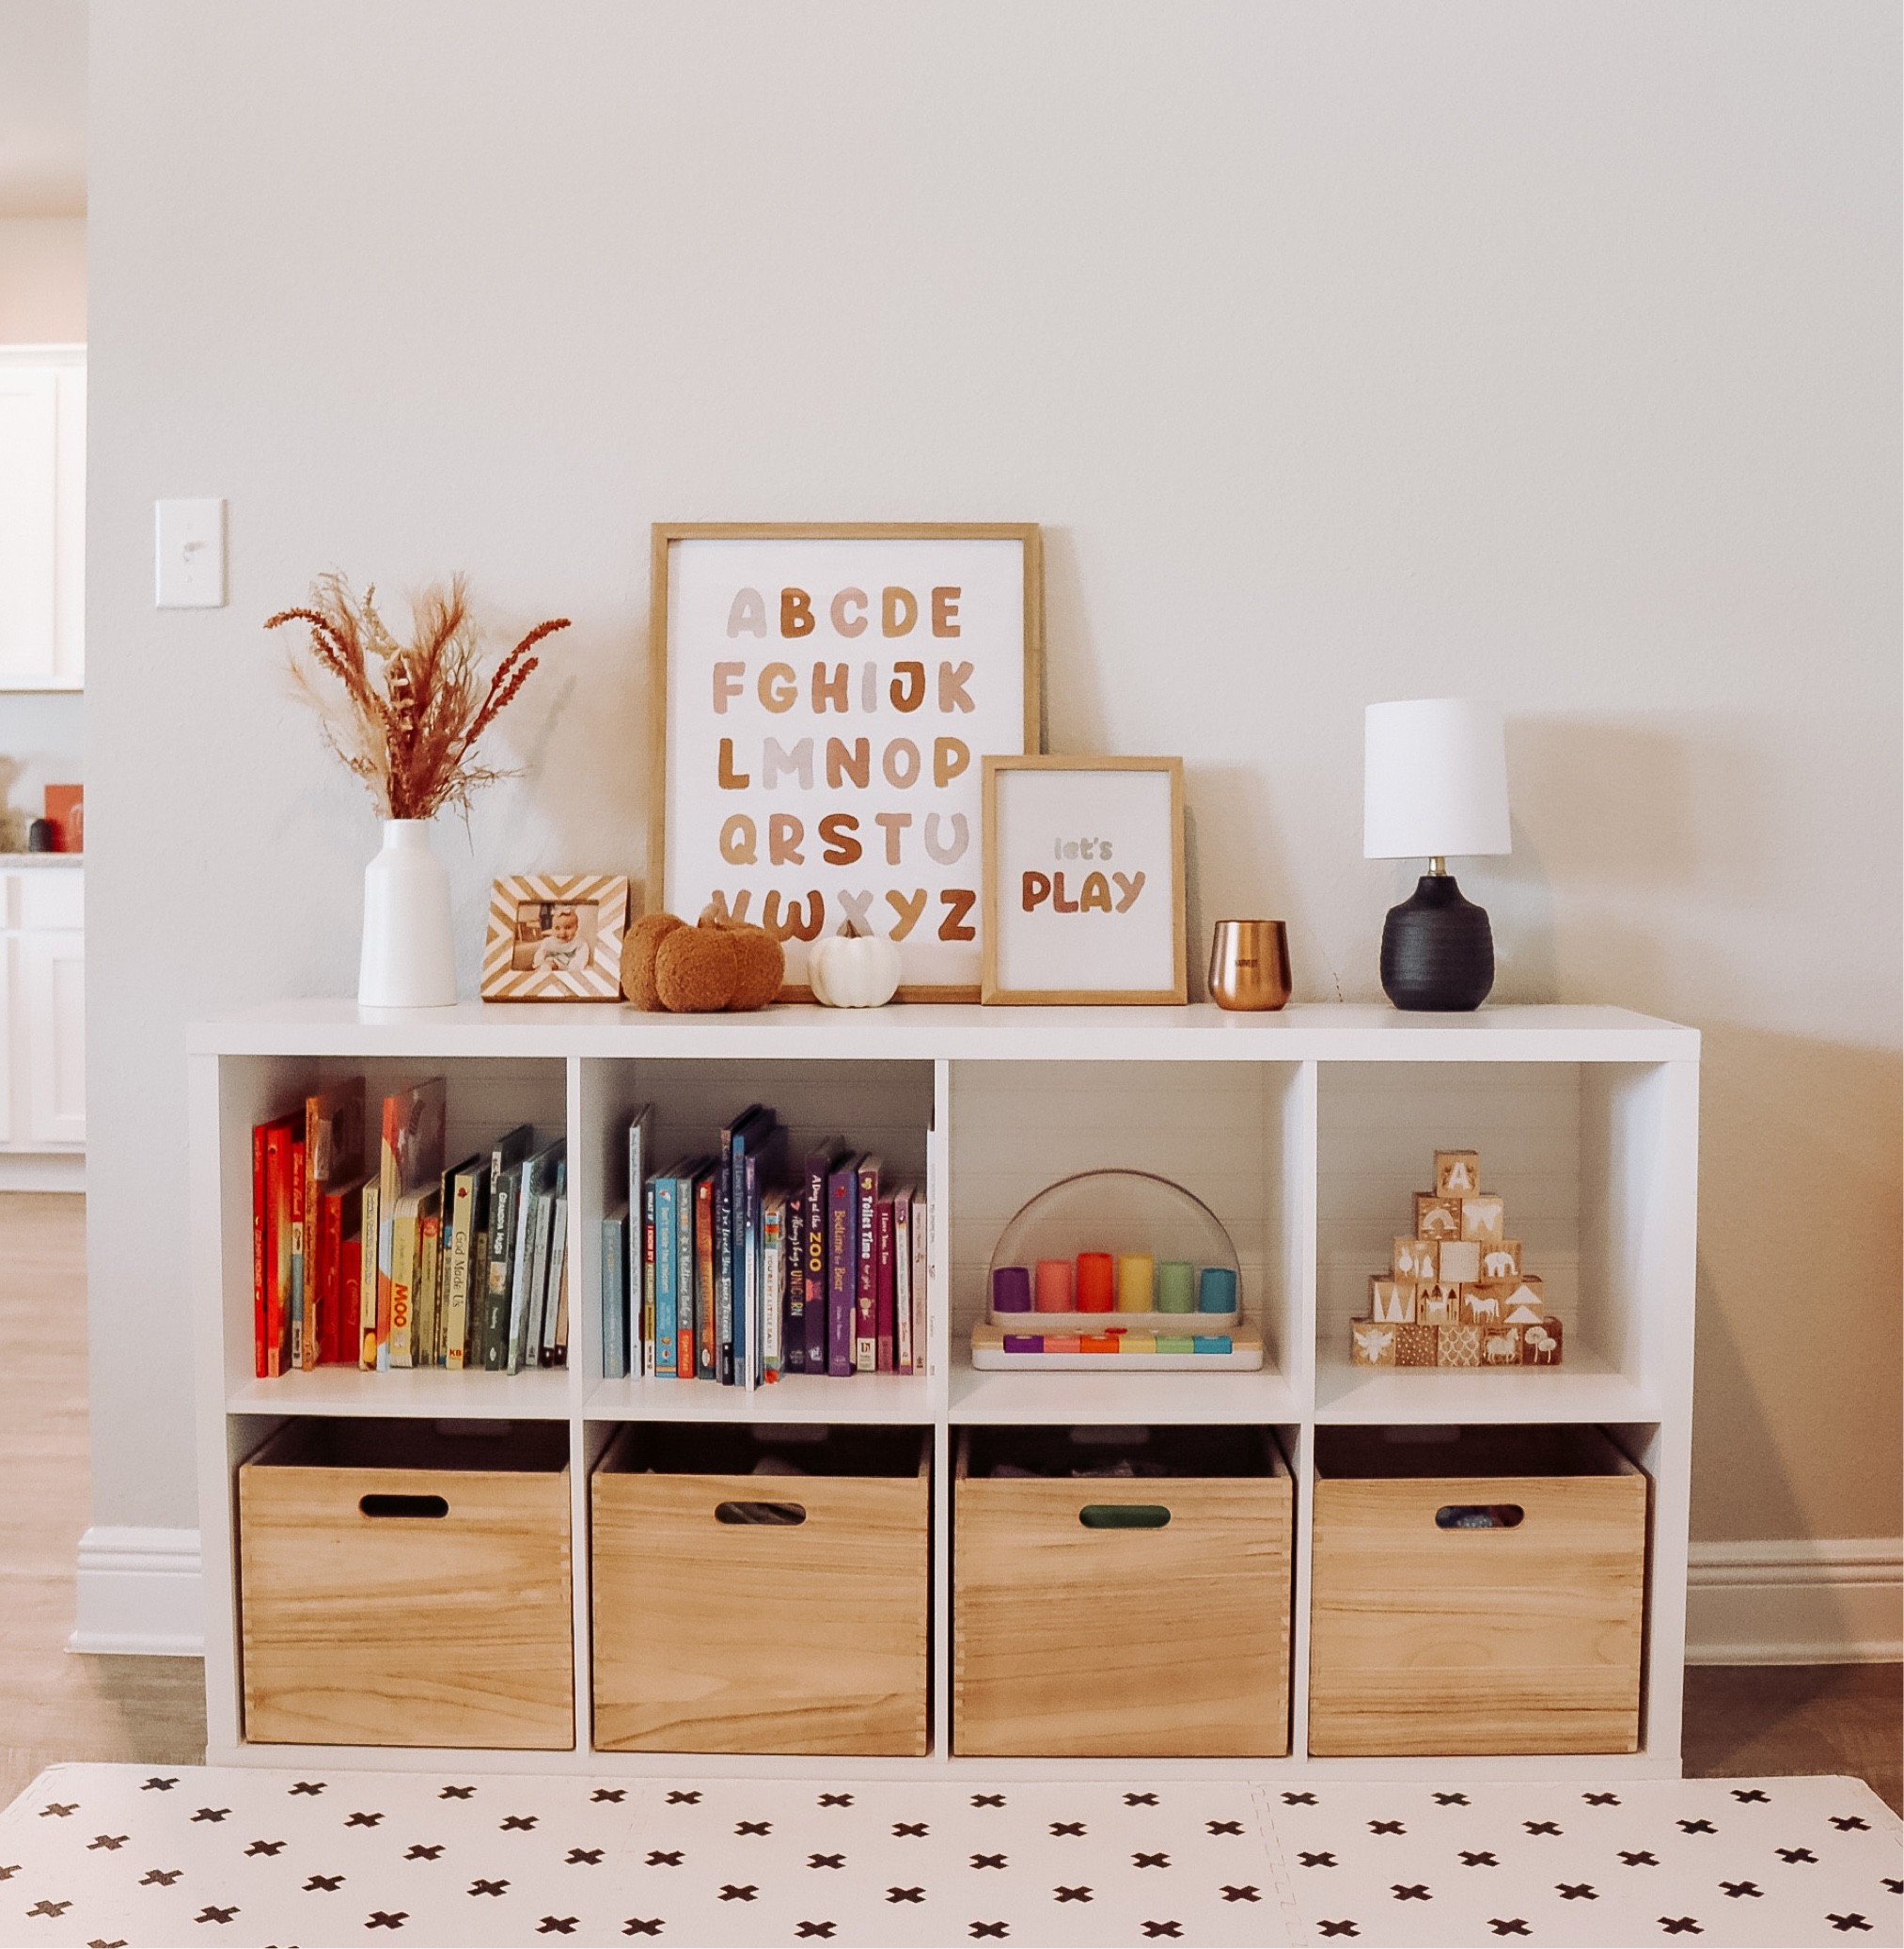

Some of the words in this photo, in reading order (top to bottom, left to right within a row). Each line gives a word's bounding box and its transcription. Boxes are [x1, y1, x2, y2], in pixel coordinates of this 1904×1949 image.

[1054, 837, 1113, 861] let's
[1021, 871, 1146, 915] PLAY
[811, 1174, 822, 1184] A
[1447, 1161, 1471, 1190] A
[809, 1185, 821, 1202] Day
[811, 1203, 820, 1212] at
[862, 1195, 873, 1229] Toilet
[789, 1215, 804, 1246] Always
[811, 1215, 821, 1230] the
[834, 1210, 846, 1255] Bedtime
[455, 1231, 467, 1255] God
[789, 1247, 803, 1262] hug
[810, 1232, 822, 1272] ZOO
[861, 1231, 873, 1260] Time
[454, 1261, 465, 1290] Made
[834, 1266, 846, 1292] Bear
[394, 1282, 408, 1328] MOO
[452, 1295, 464, 1308] Us
[791, 1269, 803, 1316] UNICORN
[449, 1348, 463, 1358] KB
